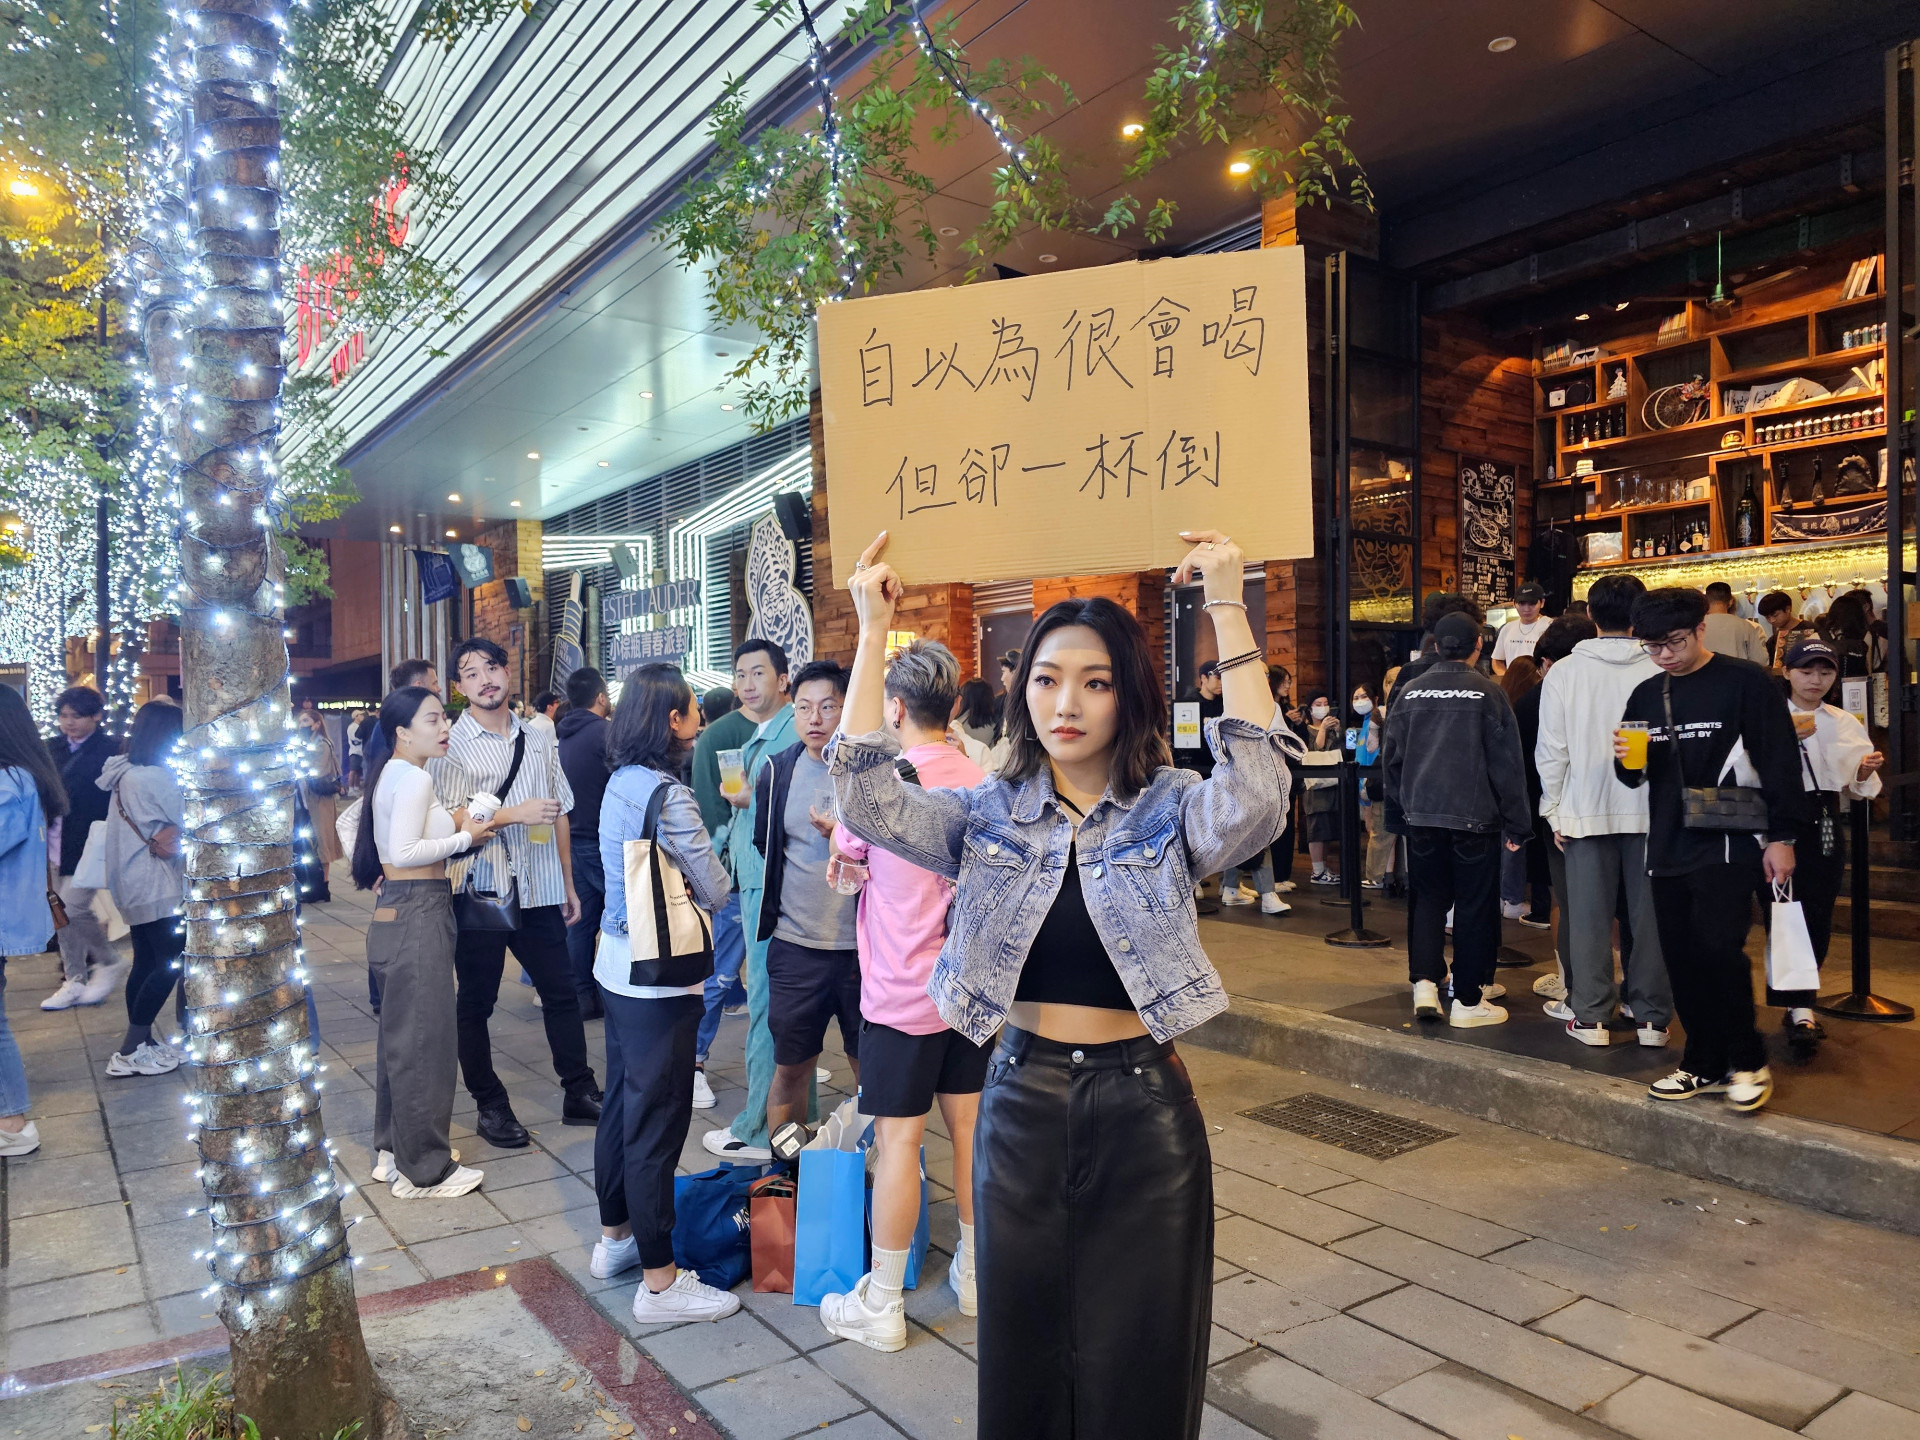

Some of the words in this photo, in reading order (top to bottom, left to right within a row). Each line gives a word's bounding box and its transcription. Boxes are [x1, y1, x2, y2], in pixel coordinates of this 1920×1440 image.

[858, 285, 1265, 407] 自以為很會喝
[886, 429, 1220, 521] 但卻一杯倒
[641, 578, 697, 615] LAUDER
[609, 626, 689, 661] 小棕瓶青春派對
[1404, 689, 1485, 700] CHRONIC
[1697, 730, 1712, 738] BY
